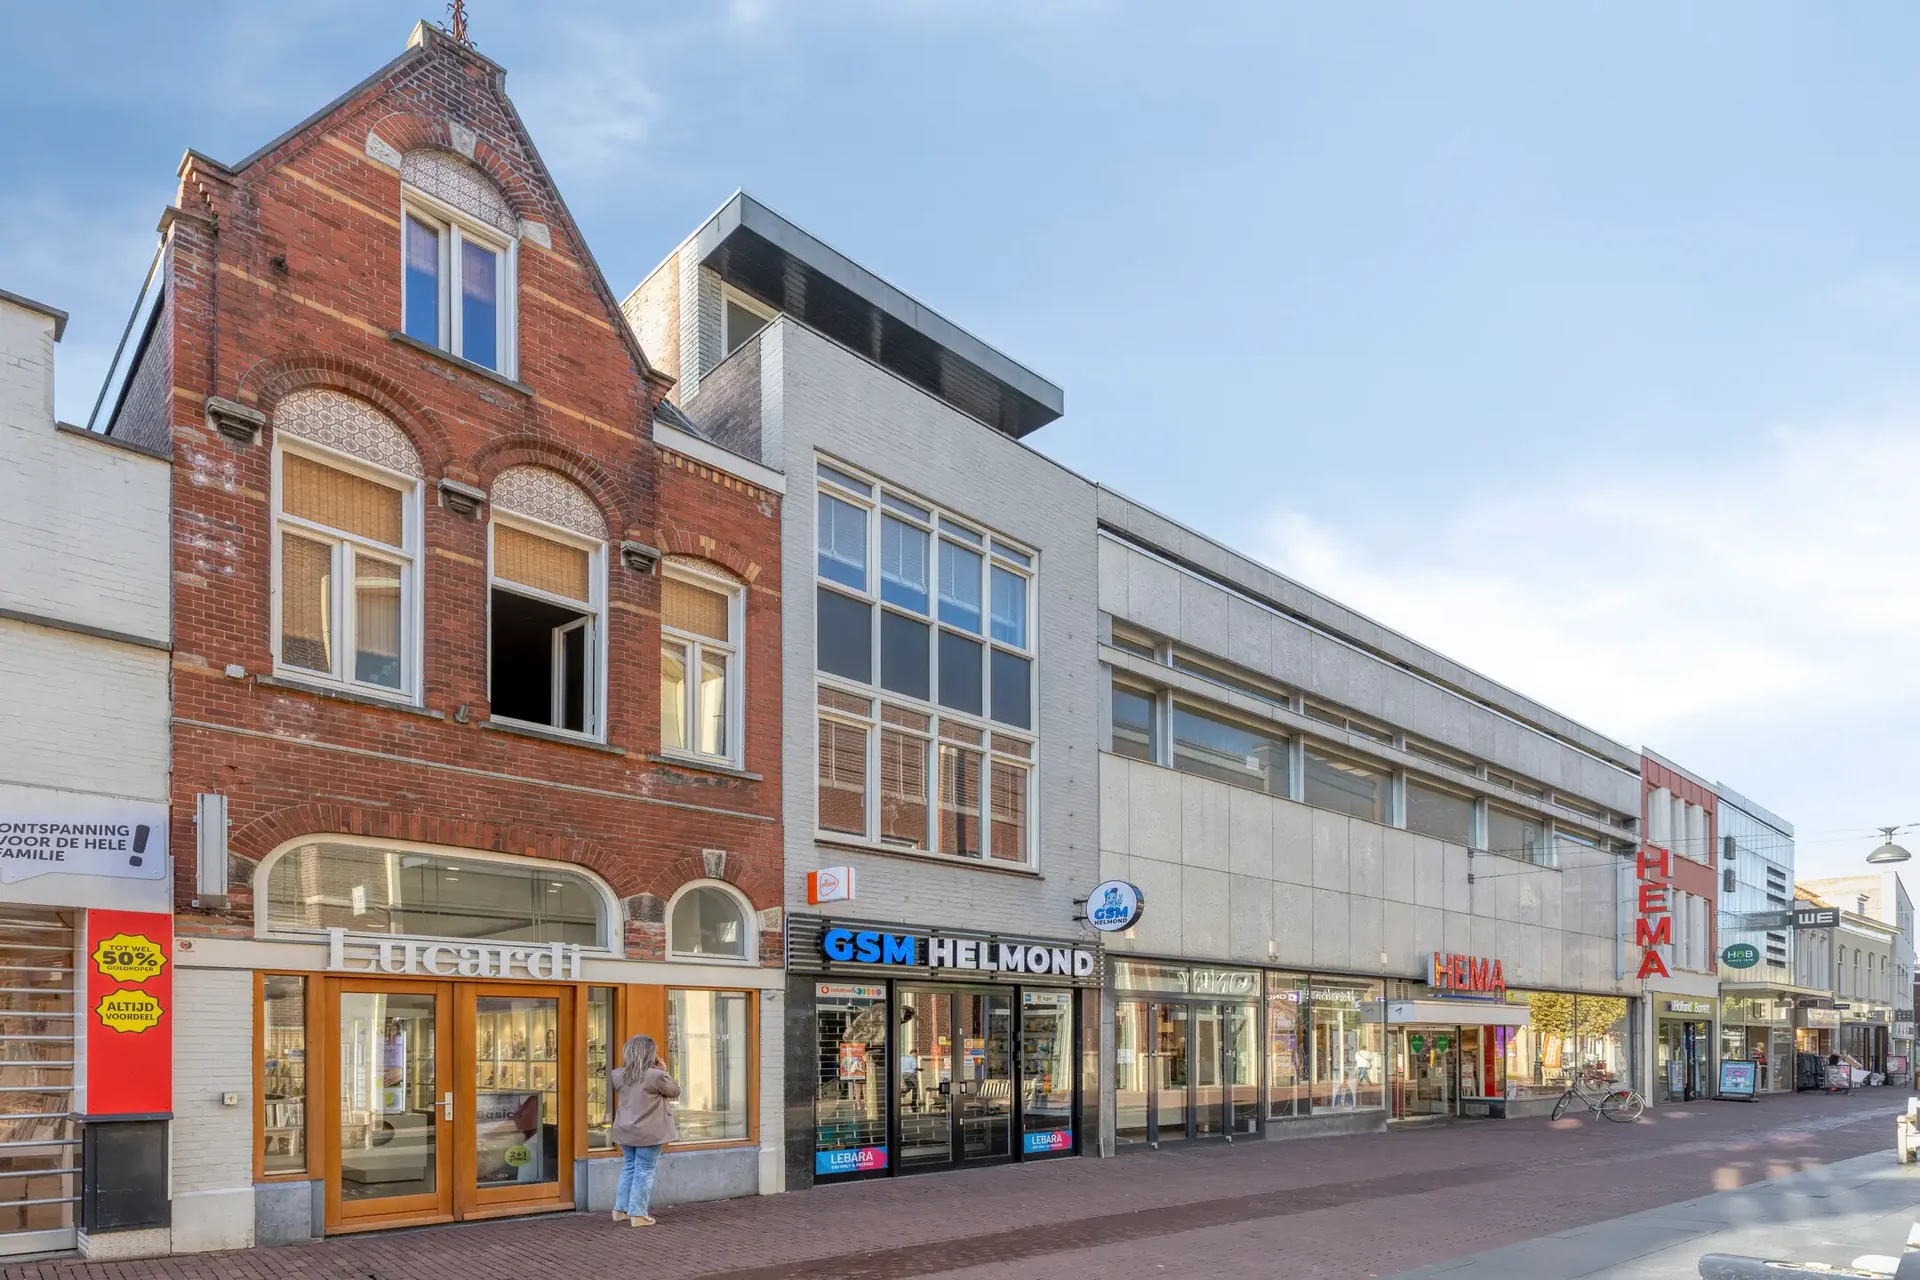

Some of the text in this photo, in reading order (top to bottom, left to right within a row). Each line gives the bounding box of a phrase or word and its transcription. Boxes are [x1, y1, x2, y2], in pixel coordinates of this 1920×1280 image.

[0, 823, 130, 836] ONTSPANNING
[56, 837, 79, 849] DE
[85, 839, 127, 851] HELE
[0, 847, 65, 861] AMILIE
[1094, 906, 1129, 919] GSM
[1636, 849, 1673, 979] HEMA
[1799, 911, 1833, 924] WE
[109, 944, 129, 952] TOT
[326, 926, 582, 980] Lucardi
[824, 928, 1095, 977] GSM HELMOND
[102, 950, 158, 967] 50%
[1433, 952, 1507, 992] HEMA
[106, 1002, 155, 1012] ALTIJD
[105, 1013, 156, 1021] VOORDEEL
[1031, 1134, 1063, 1145] LEBARA
[830, 1151, 874, 1164] LEBARA
